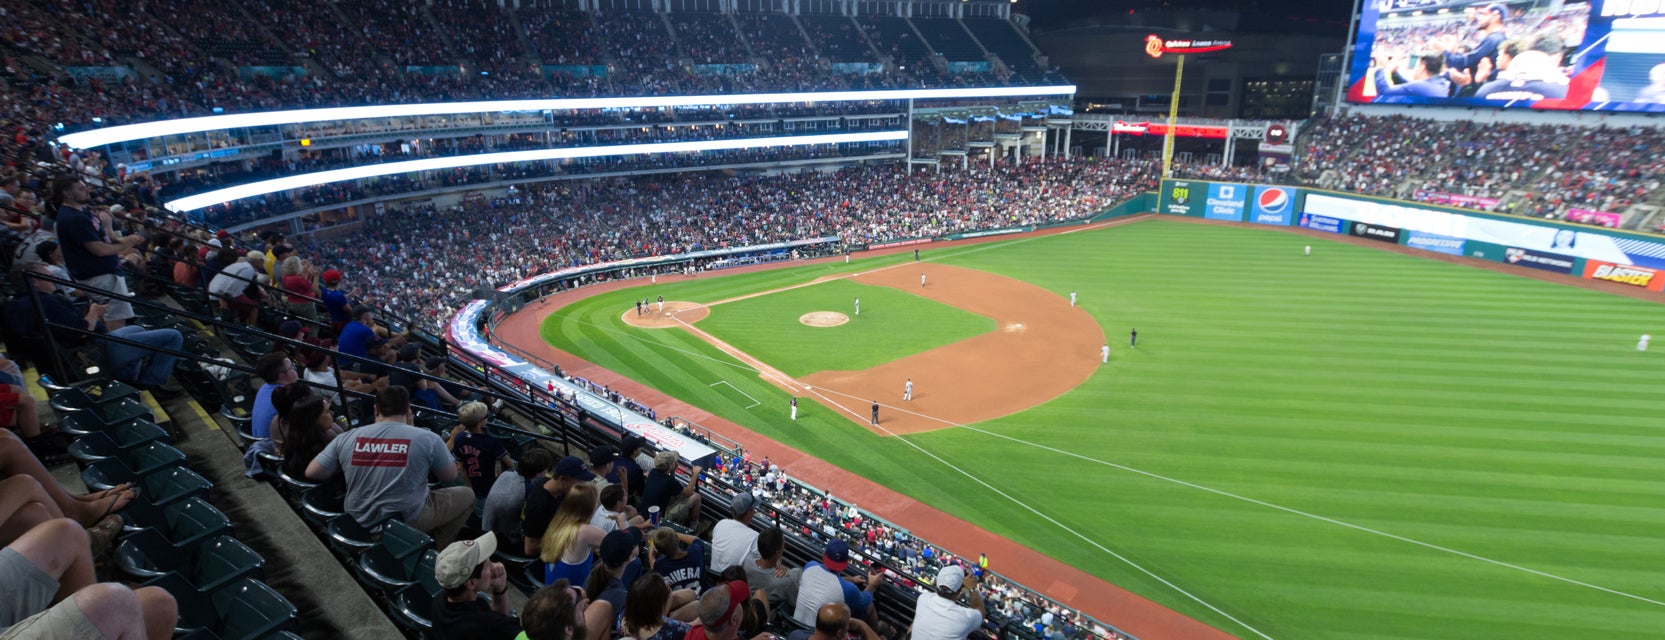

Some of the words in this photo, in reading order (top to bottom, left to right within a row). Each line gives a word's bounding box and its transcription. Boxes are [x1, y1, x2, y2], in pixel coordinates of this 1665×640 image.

[1172, 187, 1189, 200] 811
[1206, 197, 1245, 208] Cleveland
[1213, 206, 1235, 215] Clinic
[1257, 214, 1283, 223] pepsi
[355, 441, 409, 454] LAWLER
[467, 456, 482, 477] 2
[663, 566, 701, 586] RIVERA
